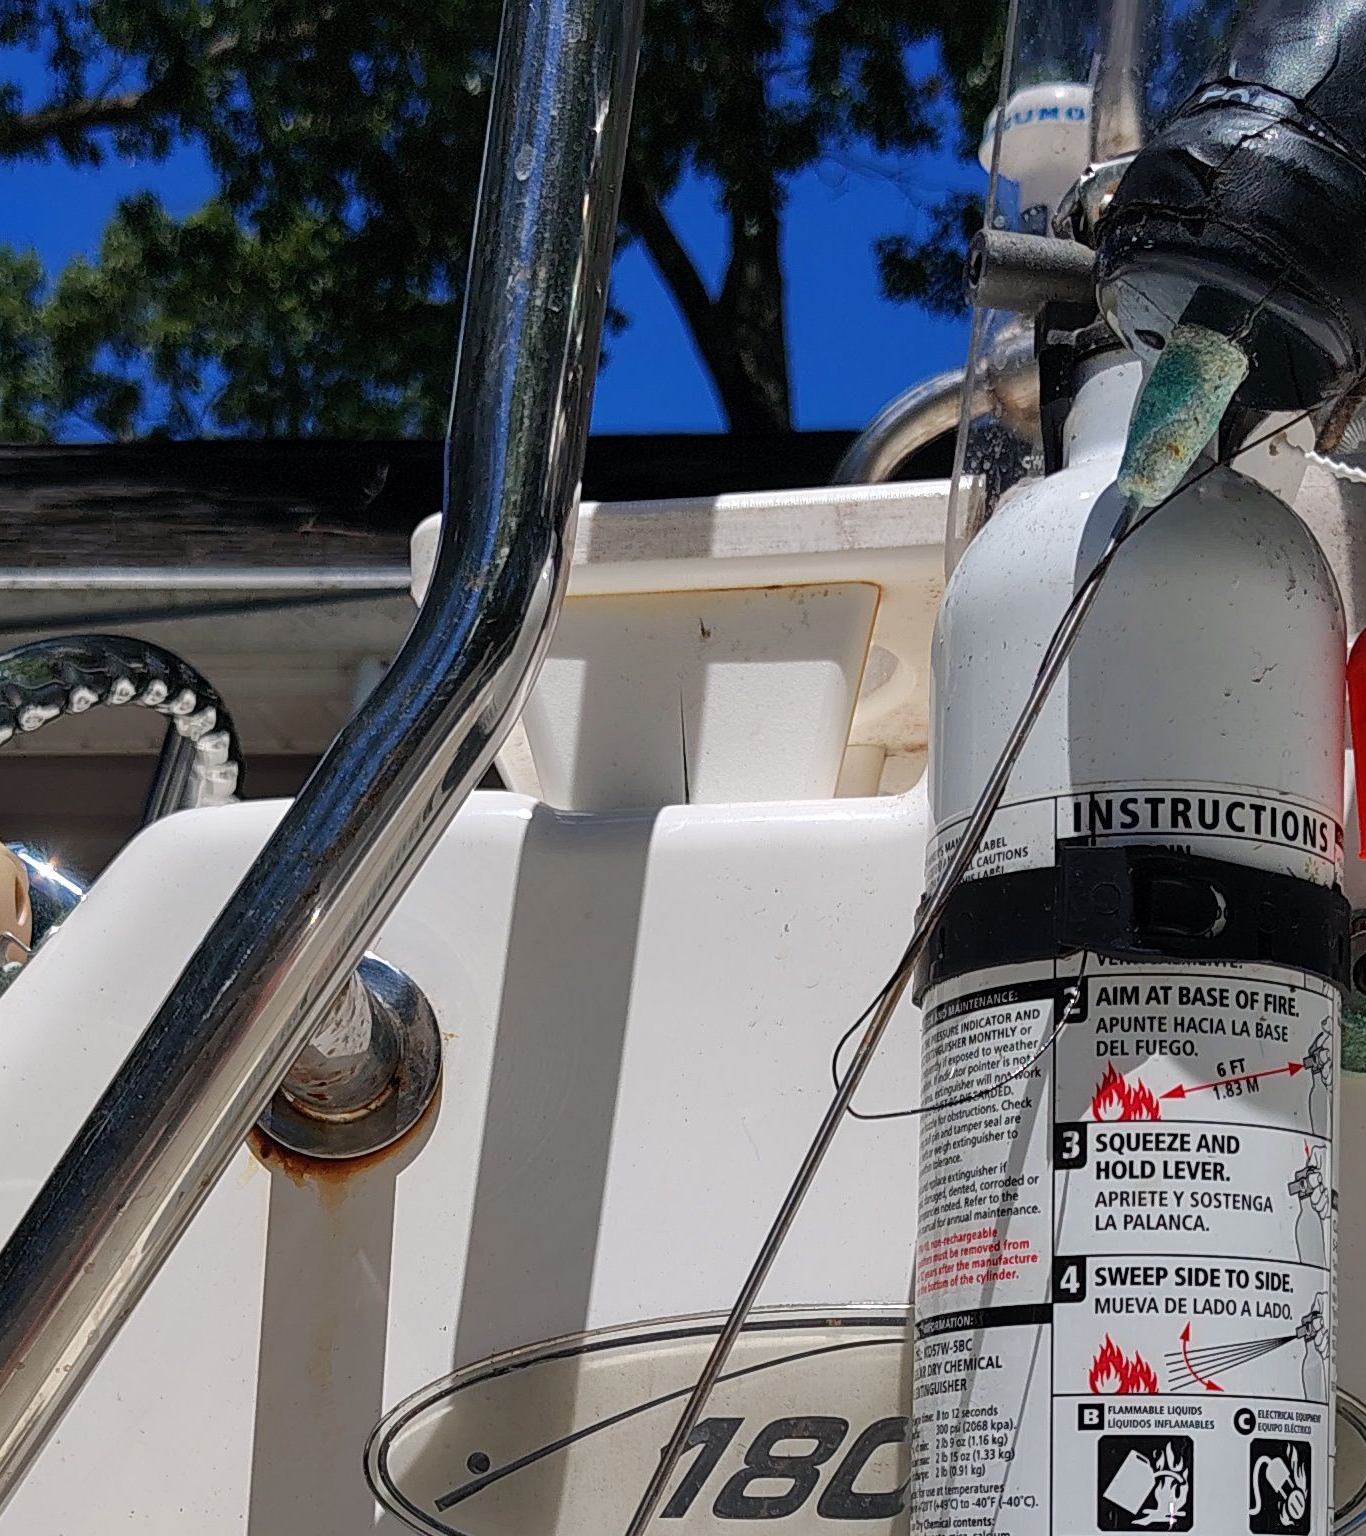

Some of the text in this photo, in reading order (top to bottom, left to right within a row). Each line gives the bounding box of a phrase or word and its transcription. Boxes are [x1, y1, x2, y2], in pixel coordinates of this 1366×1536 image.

[1073, 797, 1328, 852] INSTRUCTIONS
[978, 837, 1007, 853] LABEL
[976, 846, 1028, 867] CAUTIONS
[1096, 986, 1300, 1018] AIM AT BASE OF FIRE.
[961, 1013, 1012, 1033] INDICATOR
[1015, 1009, 1040, 1021] AND
[1096, 1016, 1288, 1042] APUNTE HACIA LA BASE
[969, 1026, 1032, 1046] MONTHLY or
[982, 1045, 991, 1056] to
[995, 1040, 1038, 1055] weather
[1096, 1040, 1198, 1057] DEL FUEGO.
[968, 1054, 1032, 1076] pointer is not
[1217, 1058, 1246, 1078] 6 FT
[977, 1074, 991, 1086] will
[1015, 1068, 1041, 1080] work
[1213, 1077, 1260, 1101] 1.83 M
[947, 1103, 998, 1122] obstructions.
[1001, 1097, 1032, 1111] Check
[954, 1120, 982, 1135] tamper
[984, 1114, 1002, 1127] seal
[1005, 1114, 1021, 1124] are
[953, 1129, 1004, 1148] extinguisher
[1007, 1130, 1018, 1139] to
[1062, 1131, 1080, 1159] 3
[1095, 1133, 1239, 1156] SQUEEZE AND
[948, 1164, 998, 1182] extinguisher
[1000, 1161, 1008, 1173] if
[1095, 1160, 1230, 1182] HOLD LEVER.
[948, 1174, 1039, 1196] dented, corroded or
[964, 1194, 986, 1208] Refer
[989, 1194, 999, 1204] to
[1002, 1190, 1019, 1202] the
[1095, 1191, 1273, 1213] APRIETE Y SOSTENGA
[947, 1210, 972, 1226] annual
[975, 1204, 1041, 1220] maintenance.
[1095, 1214, 1209, 1232] LA PALANCA.
[950, 1240, 1029, 1258] be removed from
[957, 1260, 969, 1271] the
[972, 1254, 1038, 1269] manufacture
[950, 1275, 959, 1286] of
[960, 1274, 974, 1285] the
[976, 1269, 1019, 1285] cylinder.
[1060, 1265, 1080, 1294] 4
[1095, 1267, 1294, 1293] SWEEP SIDE TO SIDE.
[1095, 1297, 1293, 1320] MUEVA DE LADO A LADO.
[944, 1355, 1003, 1374] CHEMICAL
[952, 1408, 960, 1419] 12
[962, 1405, 998, 1418] seconds
[1083, 1408, 1099, 1424] B
[1108, 1406, 1203, 1415] FLAMMABLE LIQUIDS
[1258, 1410, 1294, 1421] ELECTRICAL
[950, 1423, 961, 1435] psi
[962, 1420, 988, 1433] (2068
[991, 1418, 1017, 1432] kpa).
[1108, 1417, 1215, 1429] LÍQUIDOS INFLAMABLES
[1238, 1413, 1250, 1430] C
[1258, 1423, 1282, 1432] EQUIPO
[956, 1438, 966, 1447] oz
[968, 1435, 989, 1448] (1.16
[992, 1433, 1008, 1446] kg)
[942, 1451, 948, 1462] lb
[950, 1452, 958, 1462] 15
[960, 1453, 970, 1461] oz
[973, 1450, 995, 1462] (1.33
[998, 1447, 1015, 1462] kg)
[941, 1466, 948, 1477] lb
[950, 1465, 968, 1478] (0.91
[971, 1464, 986, 1478] kg)
[945, 1484, 1004, 1497] temperatures
[961, 1499, 969, 1508] to
[953, 1517, 995, 1528] contents:
